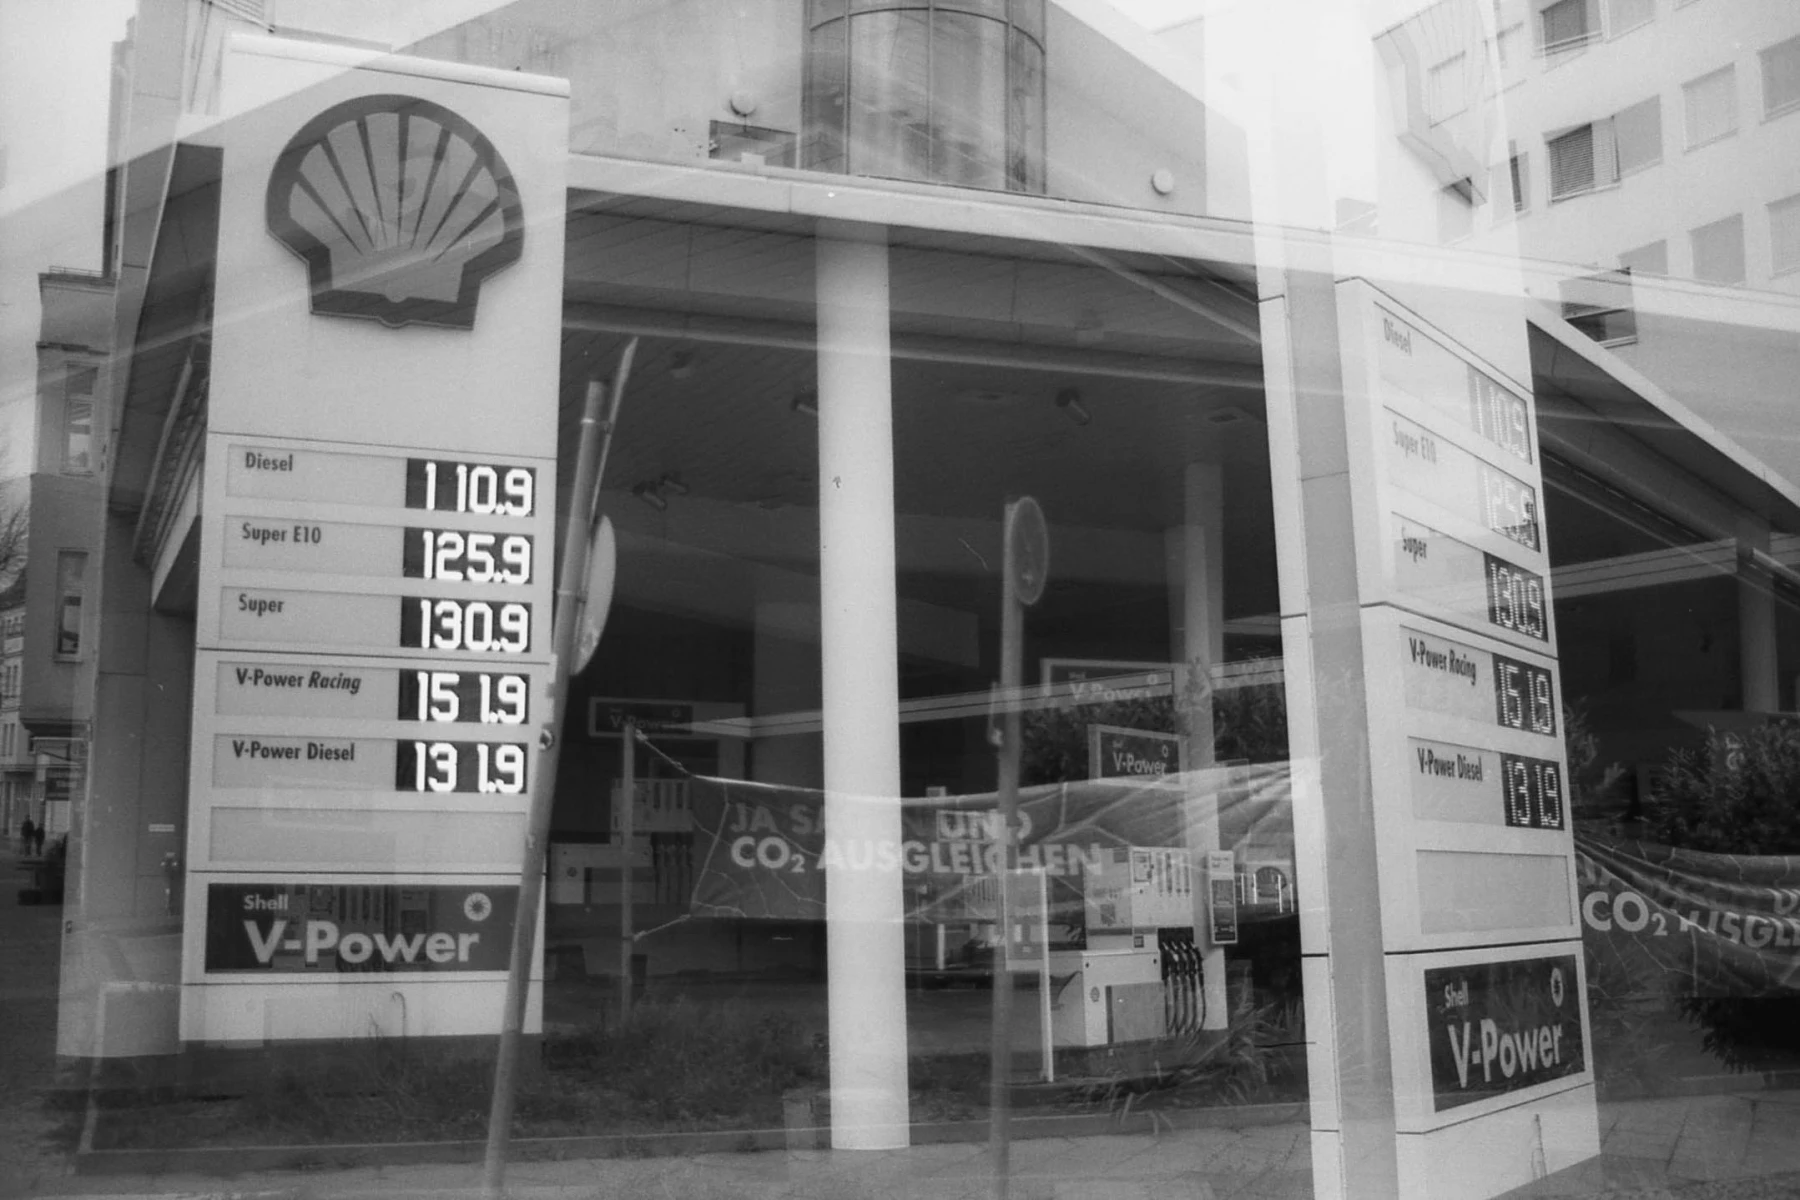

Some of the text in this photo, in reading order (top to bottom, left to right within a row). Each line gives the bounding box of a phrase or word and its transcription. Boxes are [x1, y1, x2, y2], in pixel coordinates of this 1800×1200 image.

[245, 452, 293, 471] Diesel
[242, 523, 322, 544] Super E10
[423, 530, 530, 584] 125.9
[238, 593, 284, 617] Super
[420, 599, 528, 652] 130.9
[1409, 637, 1477, 687] V-Power Racing
[236, 667, 362, 695] V-Power Racing
[232, 740, 355, 761] V-Power Diesel
[1113, 752, 1167, 776] V-Power
[1417, 747, 1483, 782] V-Power Diesel
[730, 802, 778, 834] JA
[243, 893, 288, 911] Shell
[243, 919, 480, 963] V-Power
[1444, 980, 1468, 1009] Shell
[1448, 1018, 1563, 1089] V-Power
